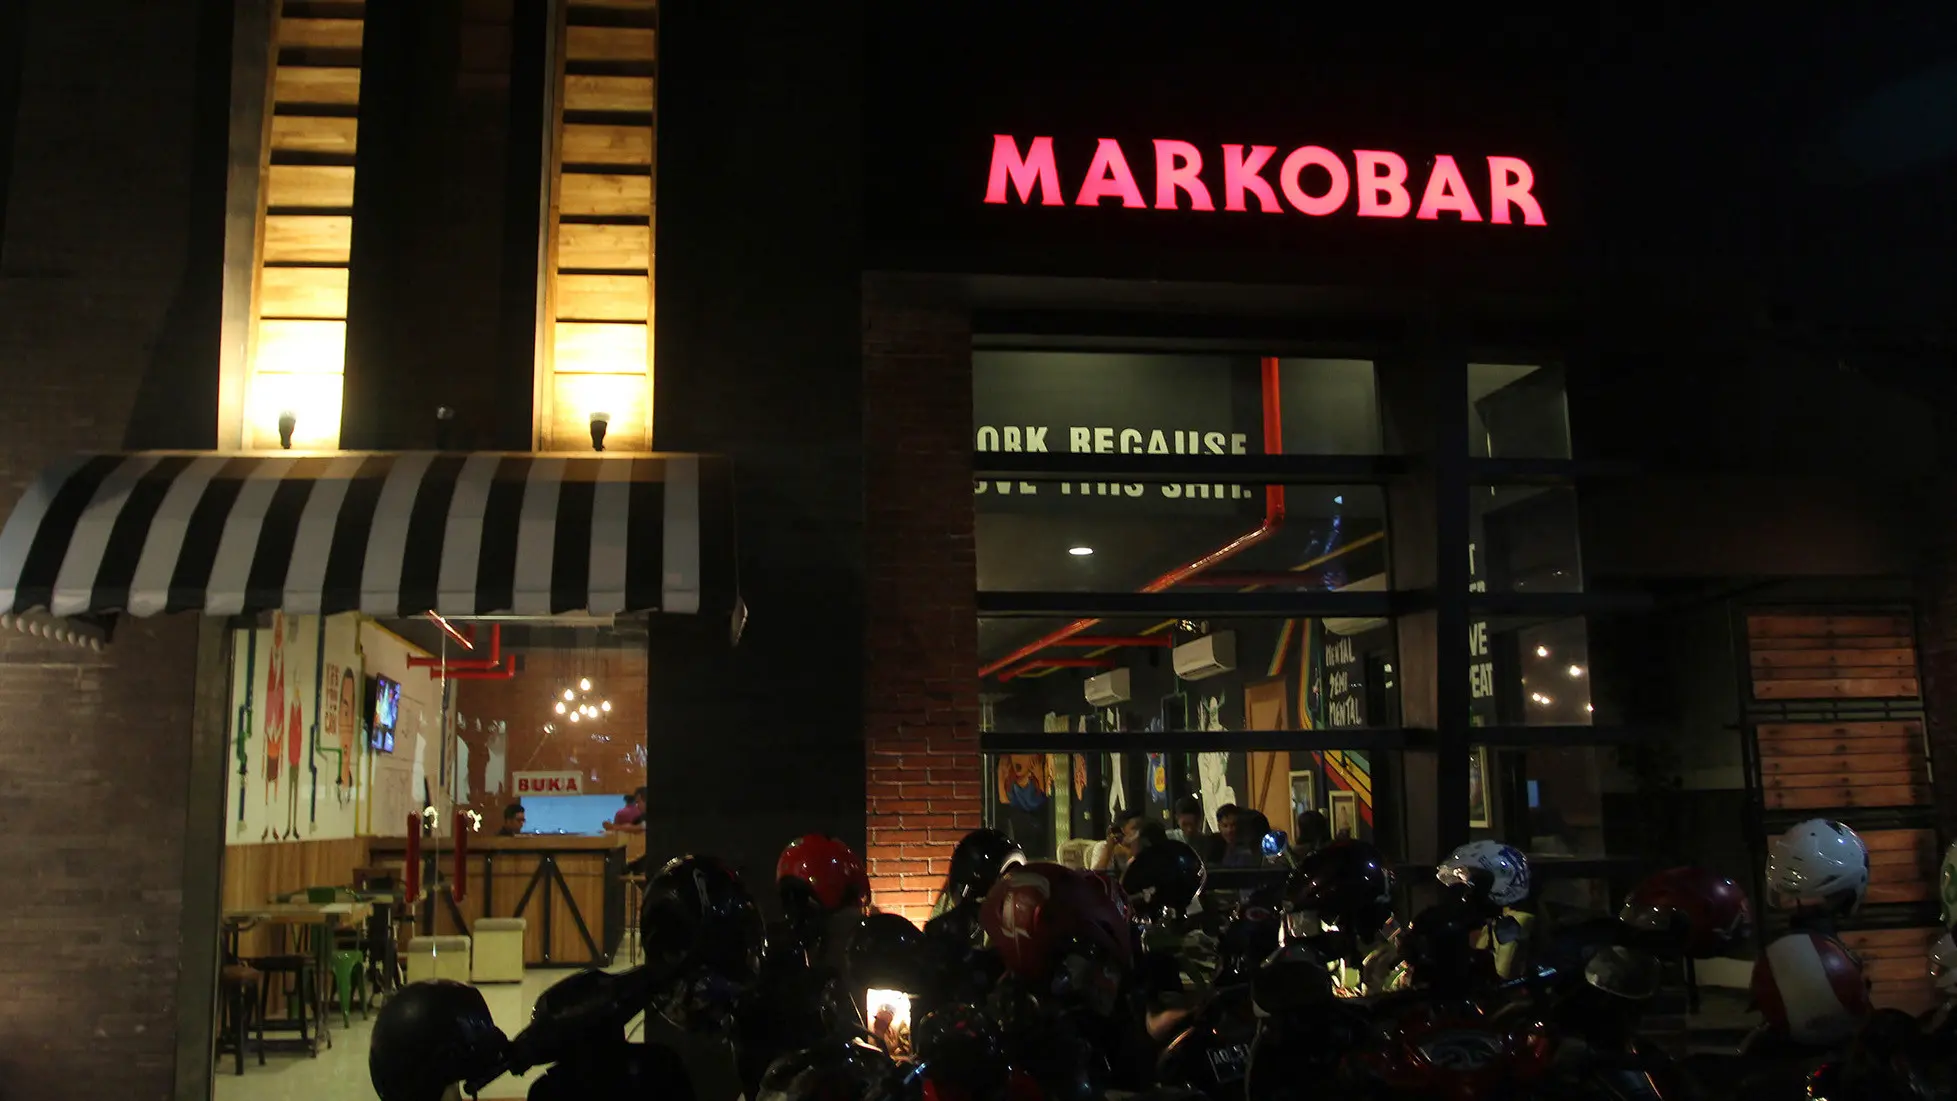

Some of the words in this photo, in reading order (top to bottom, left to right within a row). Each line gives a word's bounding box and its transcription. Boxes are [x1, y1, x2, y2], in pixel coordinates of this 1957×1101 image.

[984, 134, 1548, 226] MARKOBAR
[1070, 426, 1248, 456] BECAUSE
[1468, 662, 1494, 698] EAT
[518, 777, 578, 792] BUKA
